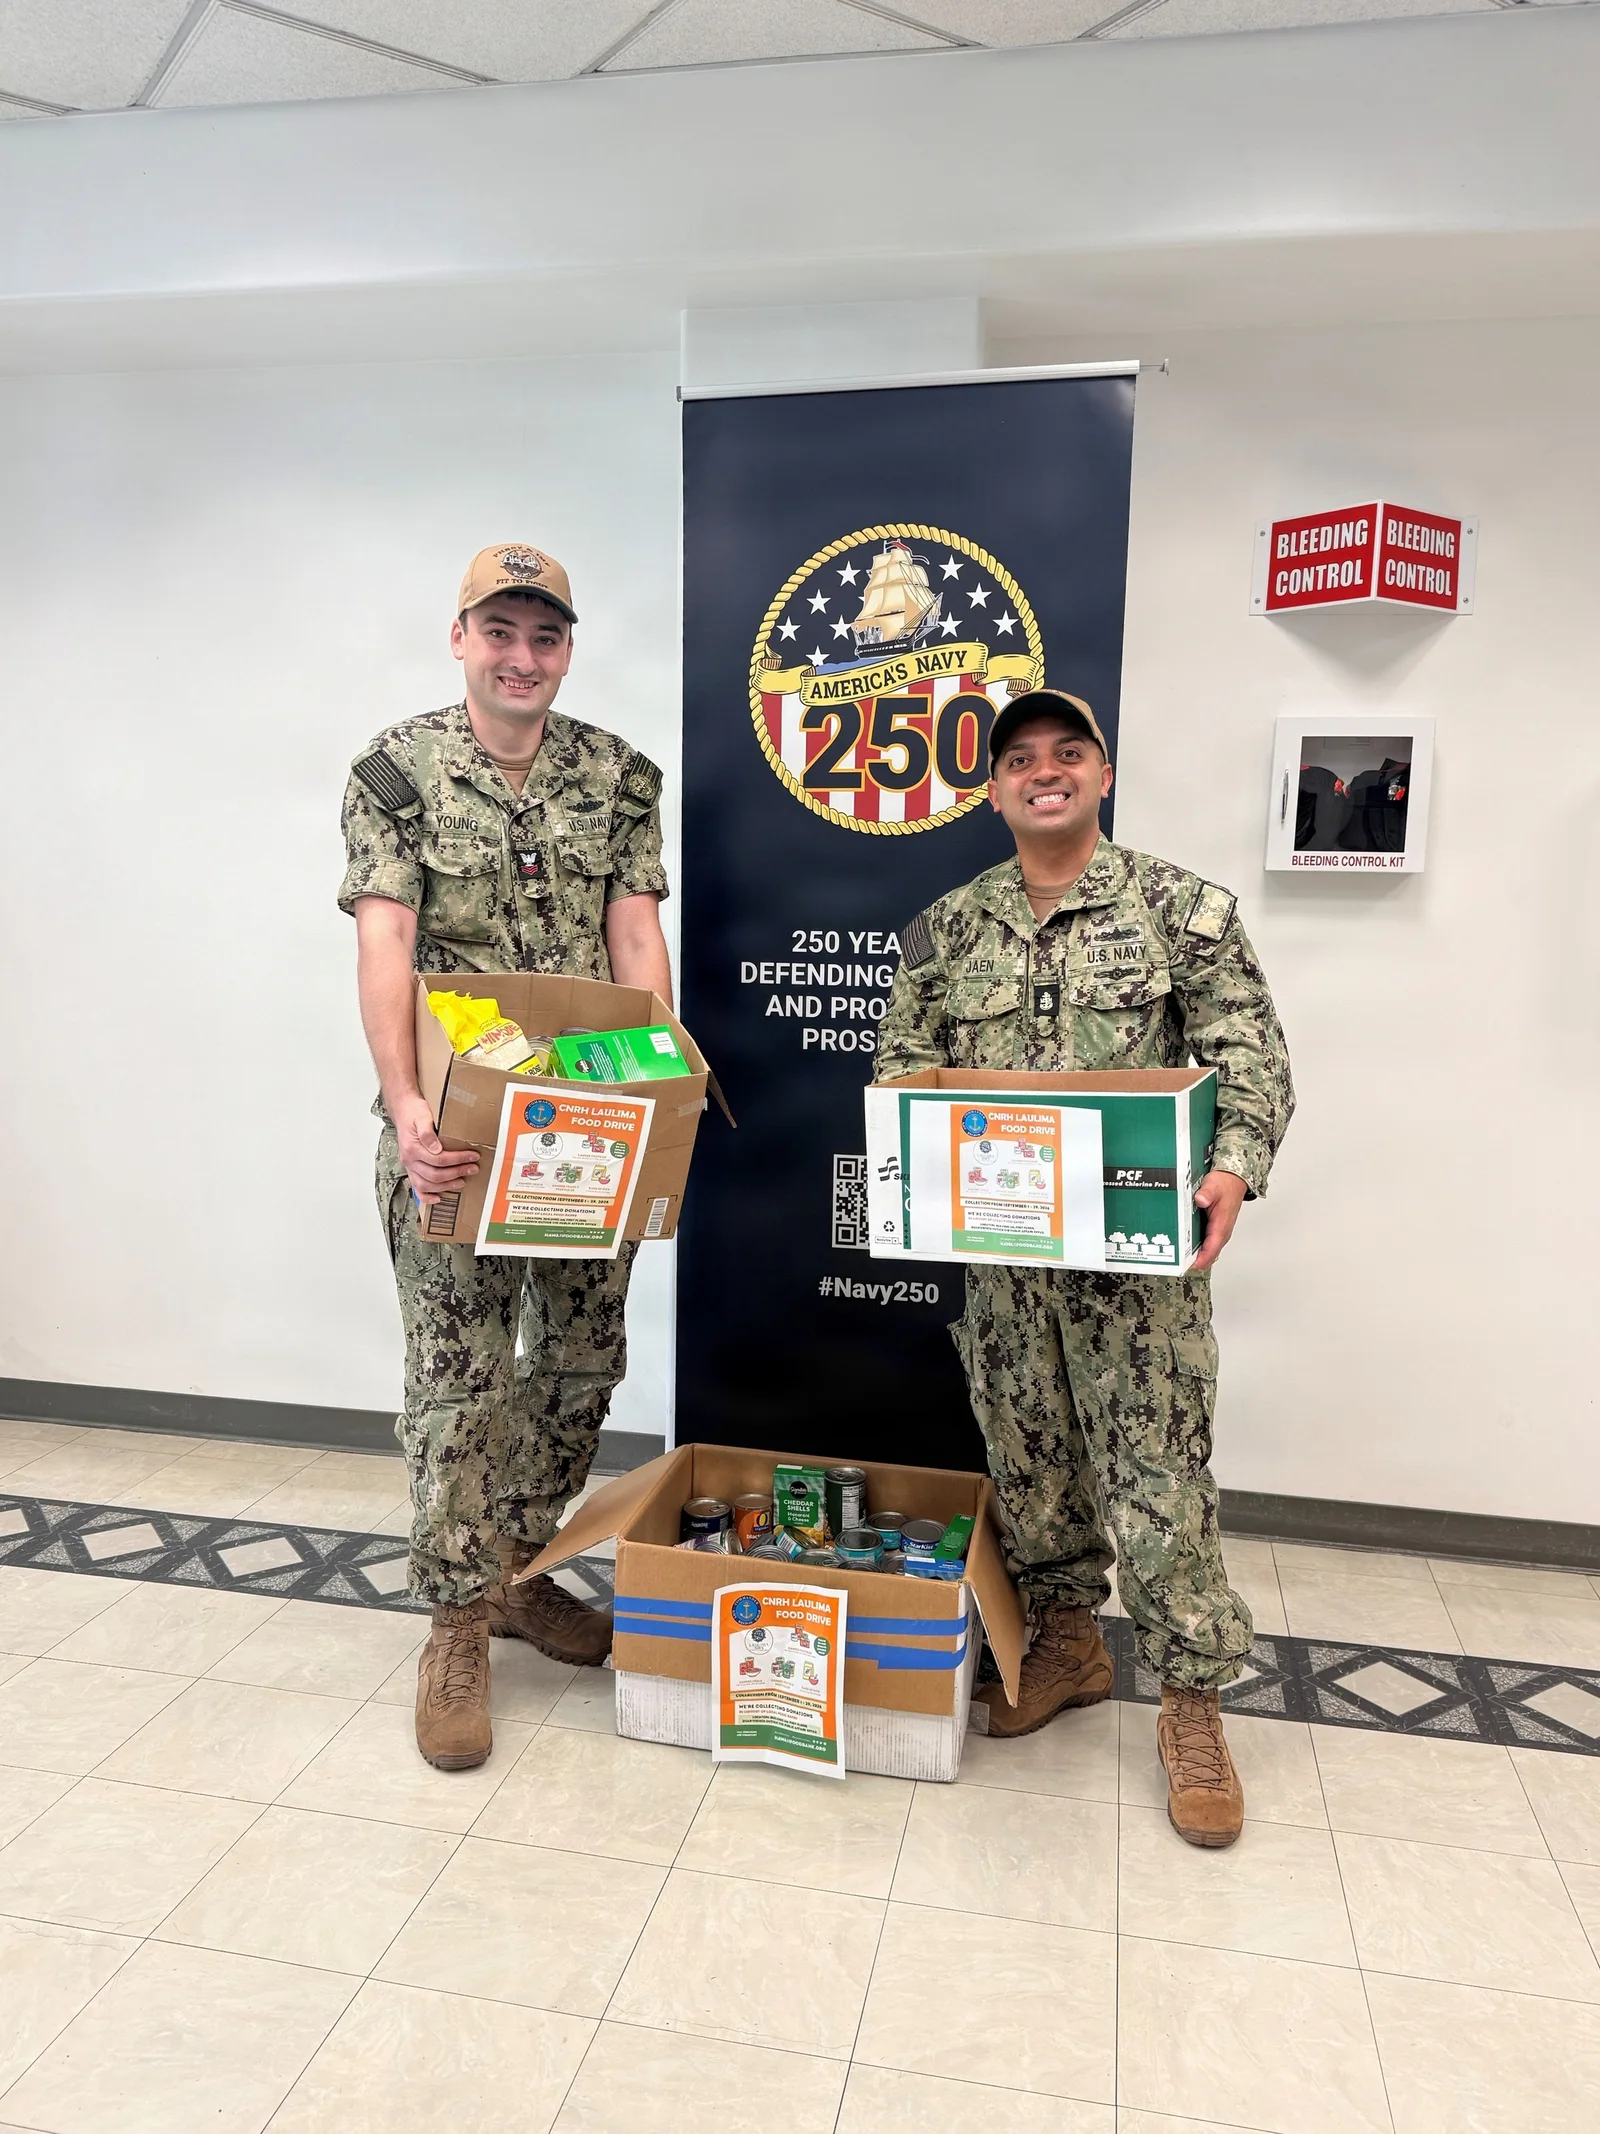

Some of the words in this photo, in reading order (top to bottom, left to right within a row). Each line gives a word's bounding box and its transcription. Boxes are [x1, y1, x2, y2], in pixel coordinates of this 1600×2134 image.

[1276, 518, 1369, 560] BLEEDING
[1386, 518, 1455, 559] BLEEDING
[1275, 559, 1364, 597] CONTROL
[1385, 559, 1452, 596] CONTROL
[810, 663, 909, 700] AMERICA'S
[915, 651, 967, 675] NAVY
[799, 691, 999, 793] 250
[435, 815, 479, 832] YOUNG
[568, 820, 588, 832] U.S.
[1291, 855, 1339, 866] BLEEDING
[1341, 856, 1387, 867] CONTROL
[1389, 857, 1405, 867] KIT
[792, 930, 840, 954] 250
[848, 931, 902, 955] YEA
[1087, 950, 1110, 963] U.S.
[1113, 945, 1147, 961] NAVY
[965, 960, 995, 973] JAEN
[741, 962, 894, 988] DEFENDING
[765, 995, 822, 1018] AND
[831, 997, 888, 1020] PRO
[802, 1028, 876, 1053] PROS
[559, 1104, 588, 1115] CNRH
[592, 1107, 637, 1119] LAULIMA
[988, 1112, 1013, 1121] CNRH
[1015, 1114, 1055, 1123] LAULIMA
[571, 1118, 601, 1128] FOOD
[604, 1121, 635, 1131] DRIVE
[1001, 1125, 1027, 1133] FOOD
[1029, 1126, 1056, 1135] DRIVE
[1116, 1170, 1143, 1181] PCF
[818, 1276, 940, 1306] #Navy250
[783, 1499, 814, 1507] CHEDDAR
[909, 1542, 934, 1550] StarKist
[762, 1597, 790, 1607] CNRH
[792, 1599, 832, 1613] LAULIMA
[776, 1610, 804, 1620] FOOD
[806, 1612, 831, 1626] DRIVE
[756, 1703, 786, 1712] COLLECTING
